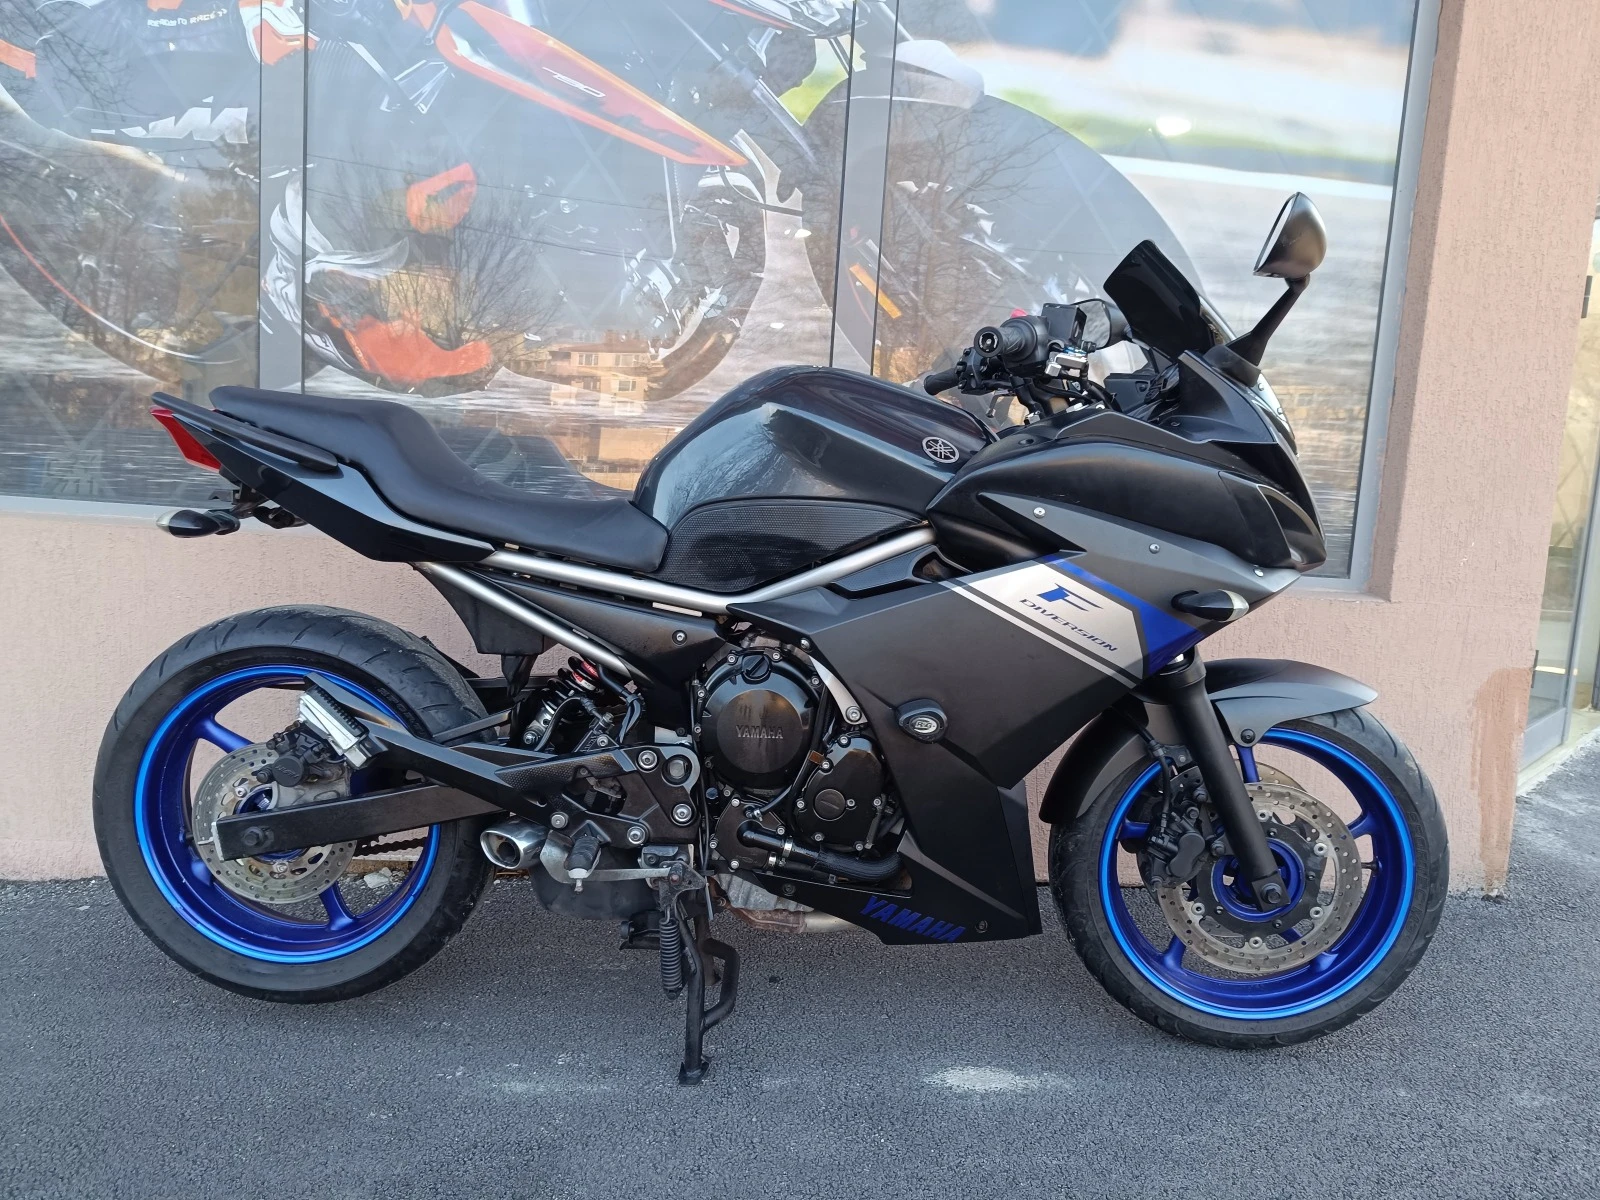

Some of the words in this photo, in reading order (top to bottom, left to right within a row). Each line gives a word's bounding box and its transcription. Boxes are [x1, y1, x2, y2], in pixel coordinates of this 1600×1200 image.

[1019, 598, 1119, 652] DIVERSION
[735, 724, 784, 740] YAMAHA
[860, 895, 967, 943] YAMAHA
